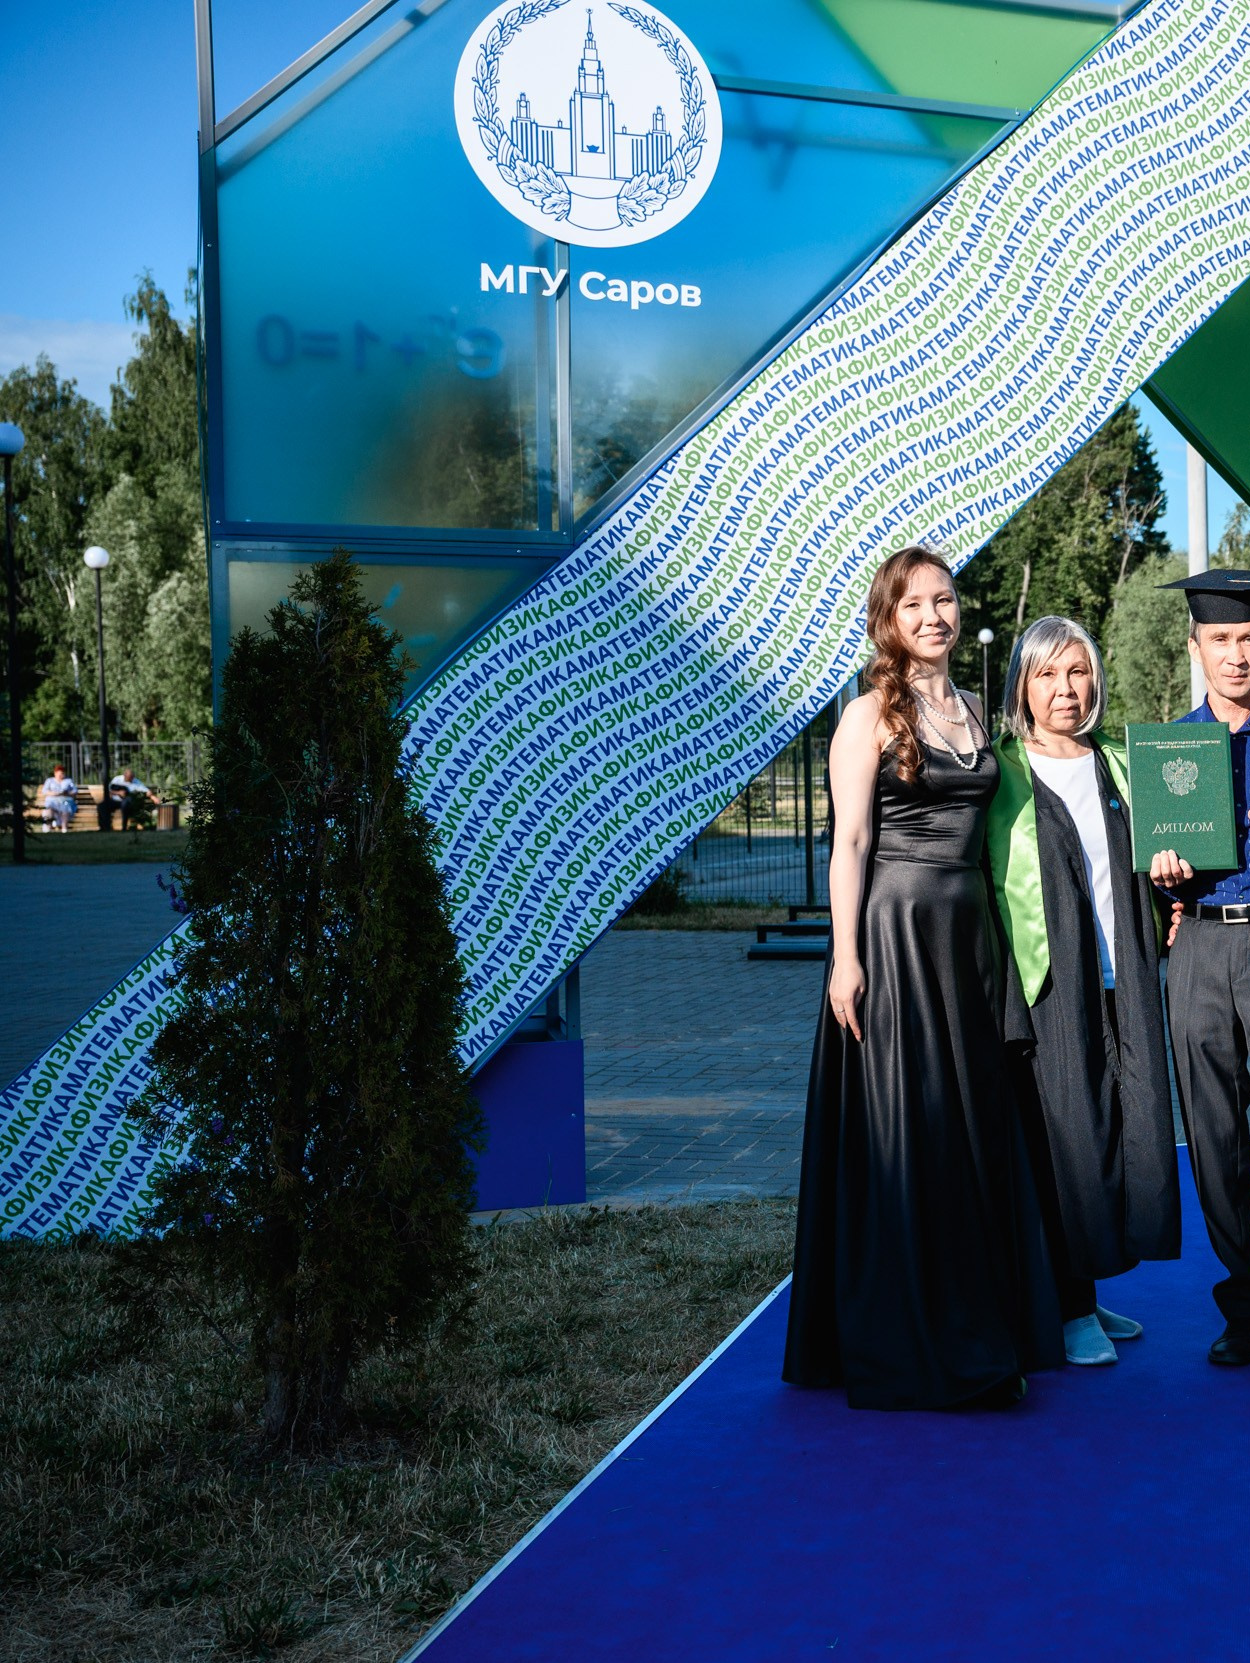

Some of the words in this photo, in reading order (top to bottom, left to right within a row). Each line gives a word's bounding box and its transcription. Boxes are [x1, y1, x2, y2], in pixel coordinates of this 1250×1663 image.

[480, 263, 568, 297] МГУ
[579, 271, 702, 310] Саров
[1152, 821, 1214, 835] ДИПЛОМ
